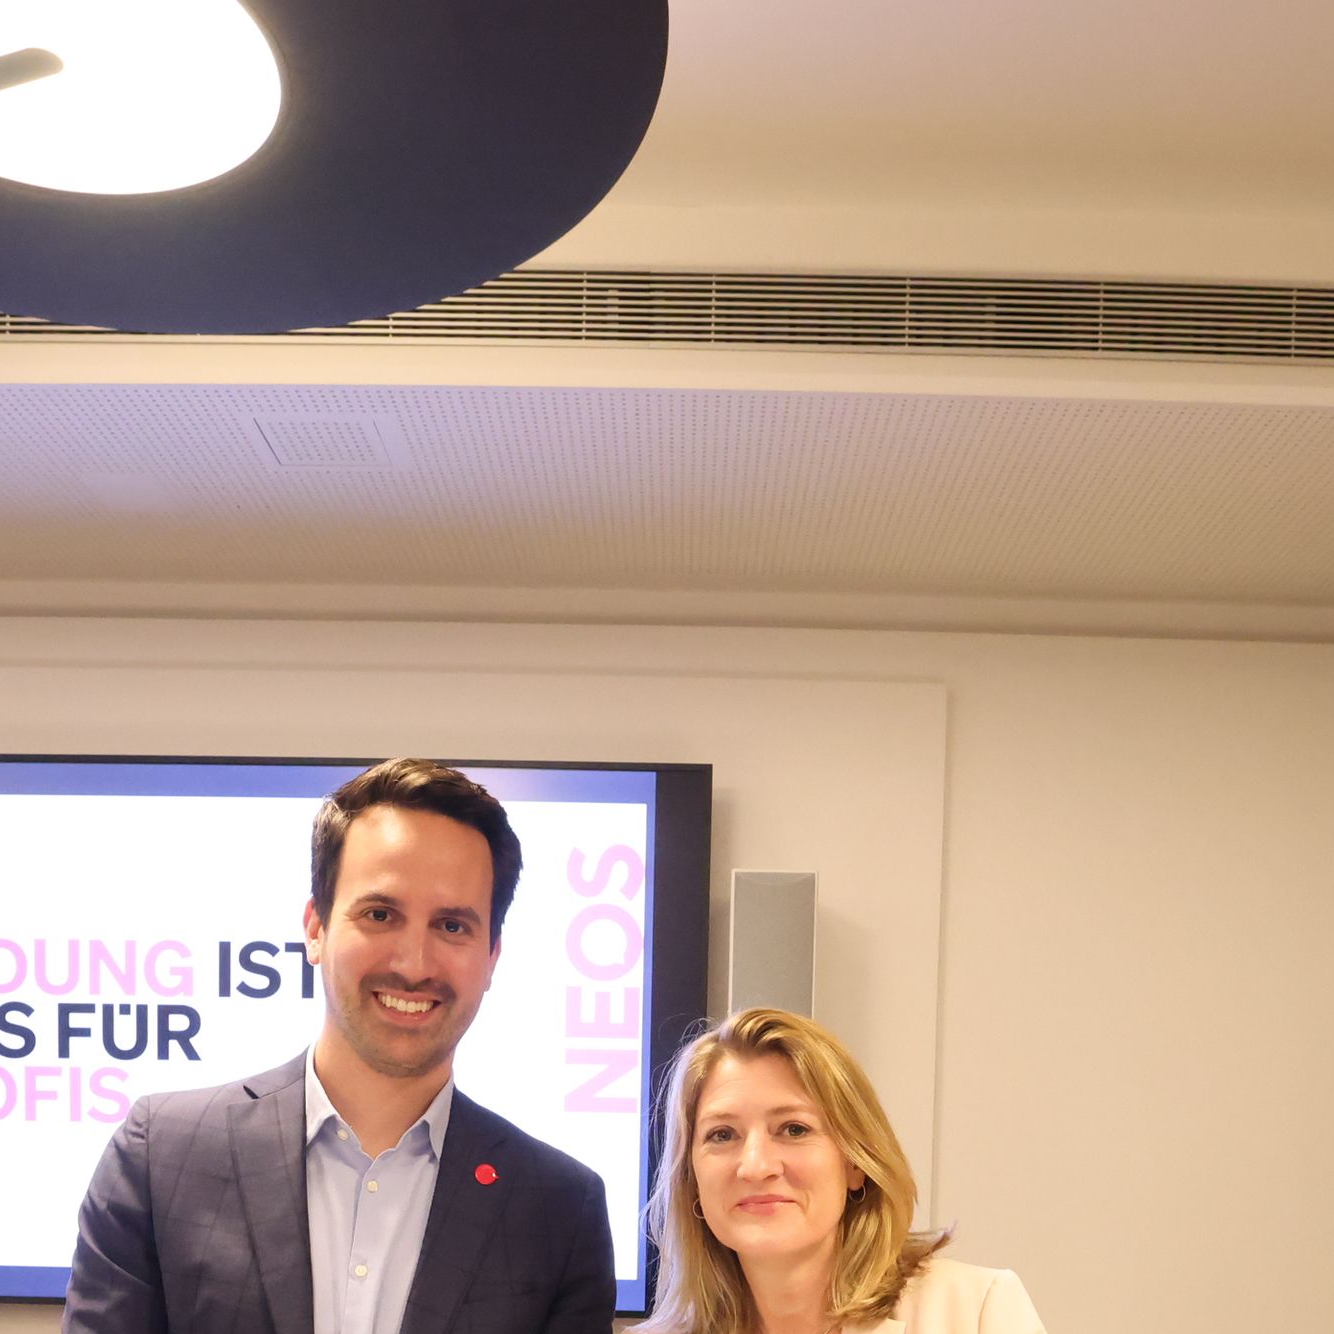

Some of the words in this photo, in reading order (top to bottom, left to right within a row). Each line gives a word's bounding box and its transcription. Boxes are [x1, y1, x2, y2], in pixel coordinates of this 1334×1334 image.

[218, 940, 315, 999] IST
[564, 844, 646, 1114] NEOS
[57, 1002, 202, 1062] FÜR
